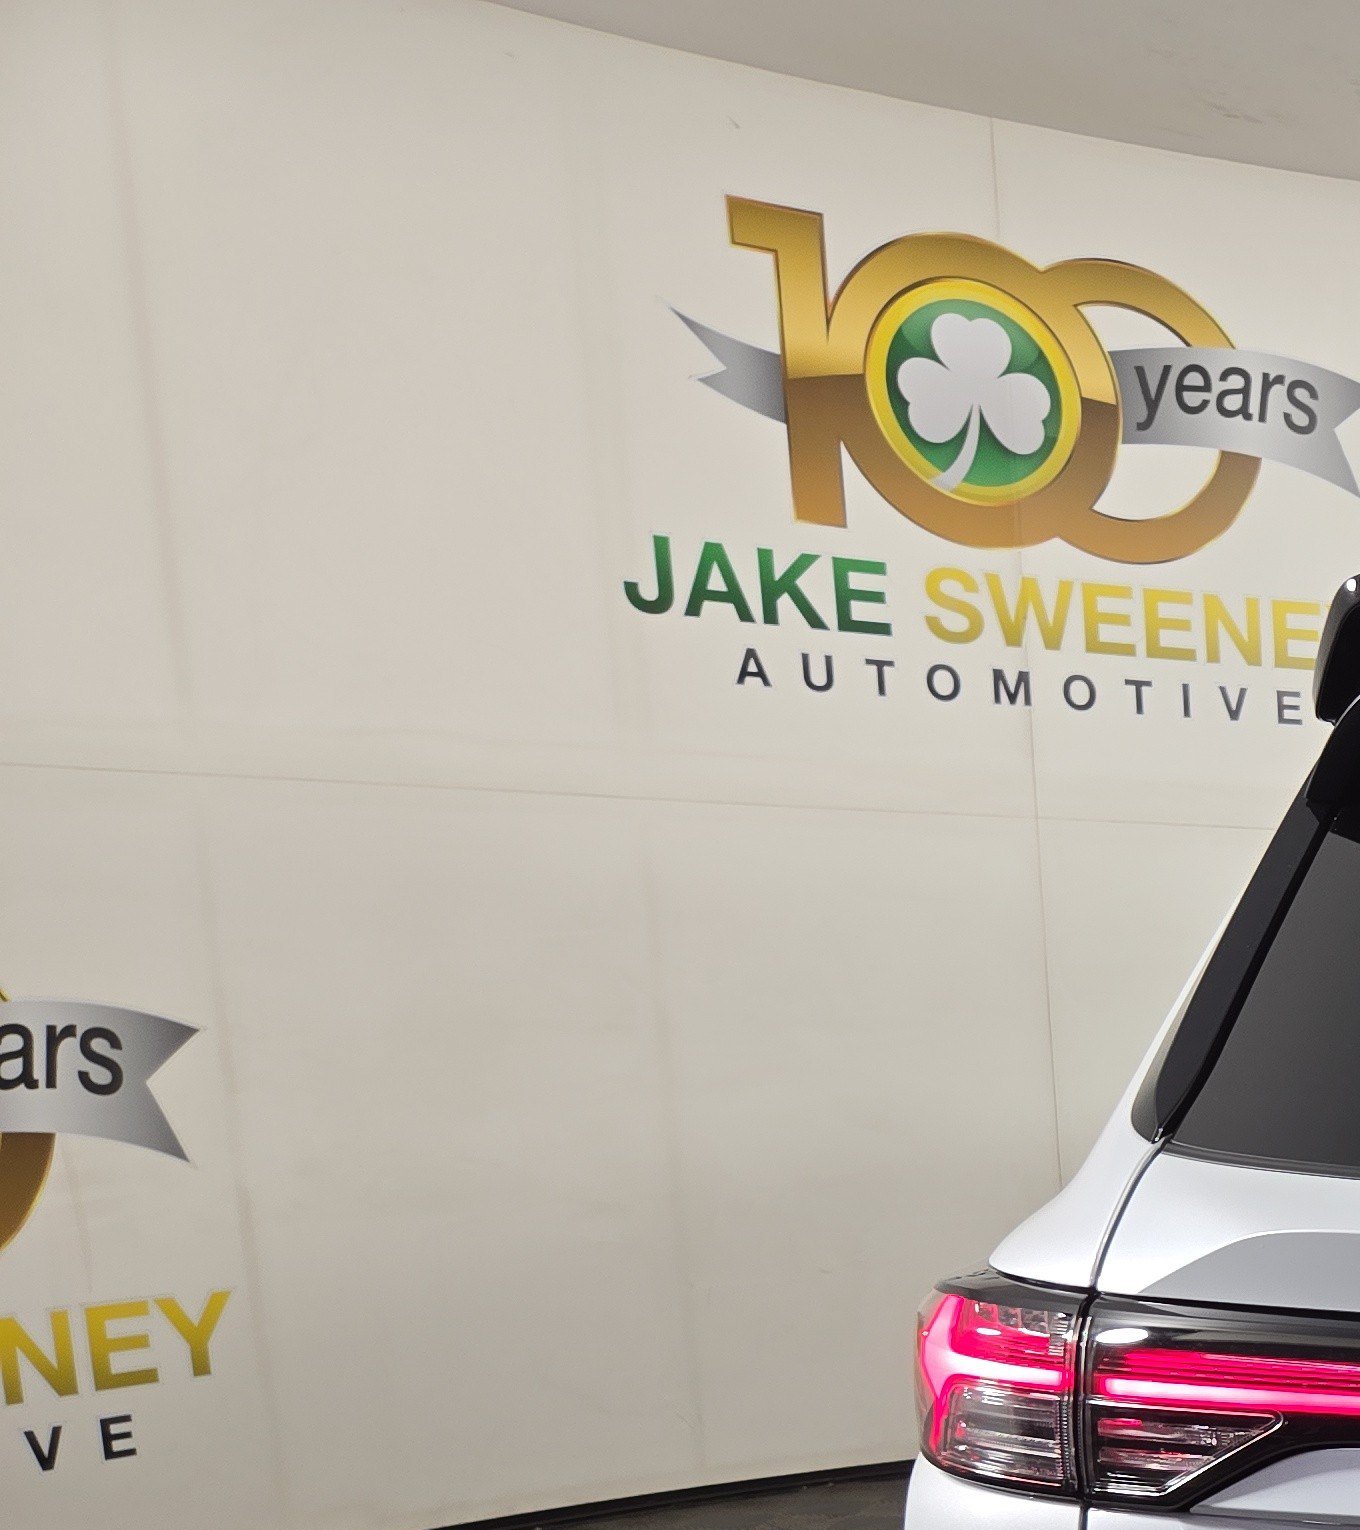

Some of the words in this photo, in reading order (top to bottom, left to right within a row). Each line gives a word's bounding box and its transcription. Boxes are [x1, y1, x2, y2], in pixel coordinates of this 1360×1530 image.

[724, 194, 1262, 564] 100
[1134, 360, 1320, 434] years
[623, 535, 892, 636] JAKE
[924, 566, 1330, 670] SWEENE
[736, 647, 1303, 726] AUTOMOTIVE
